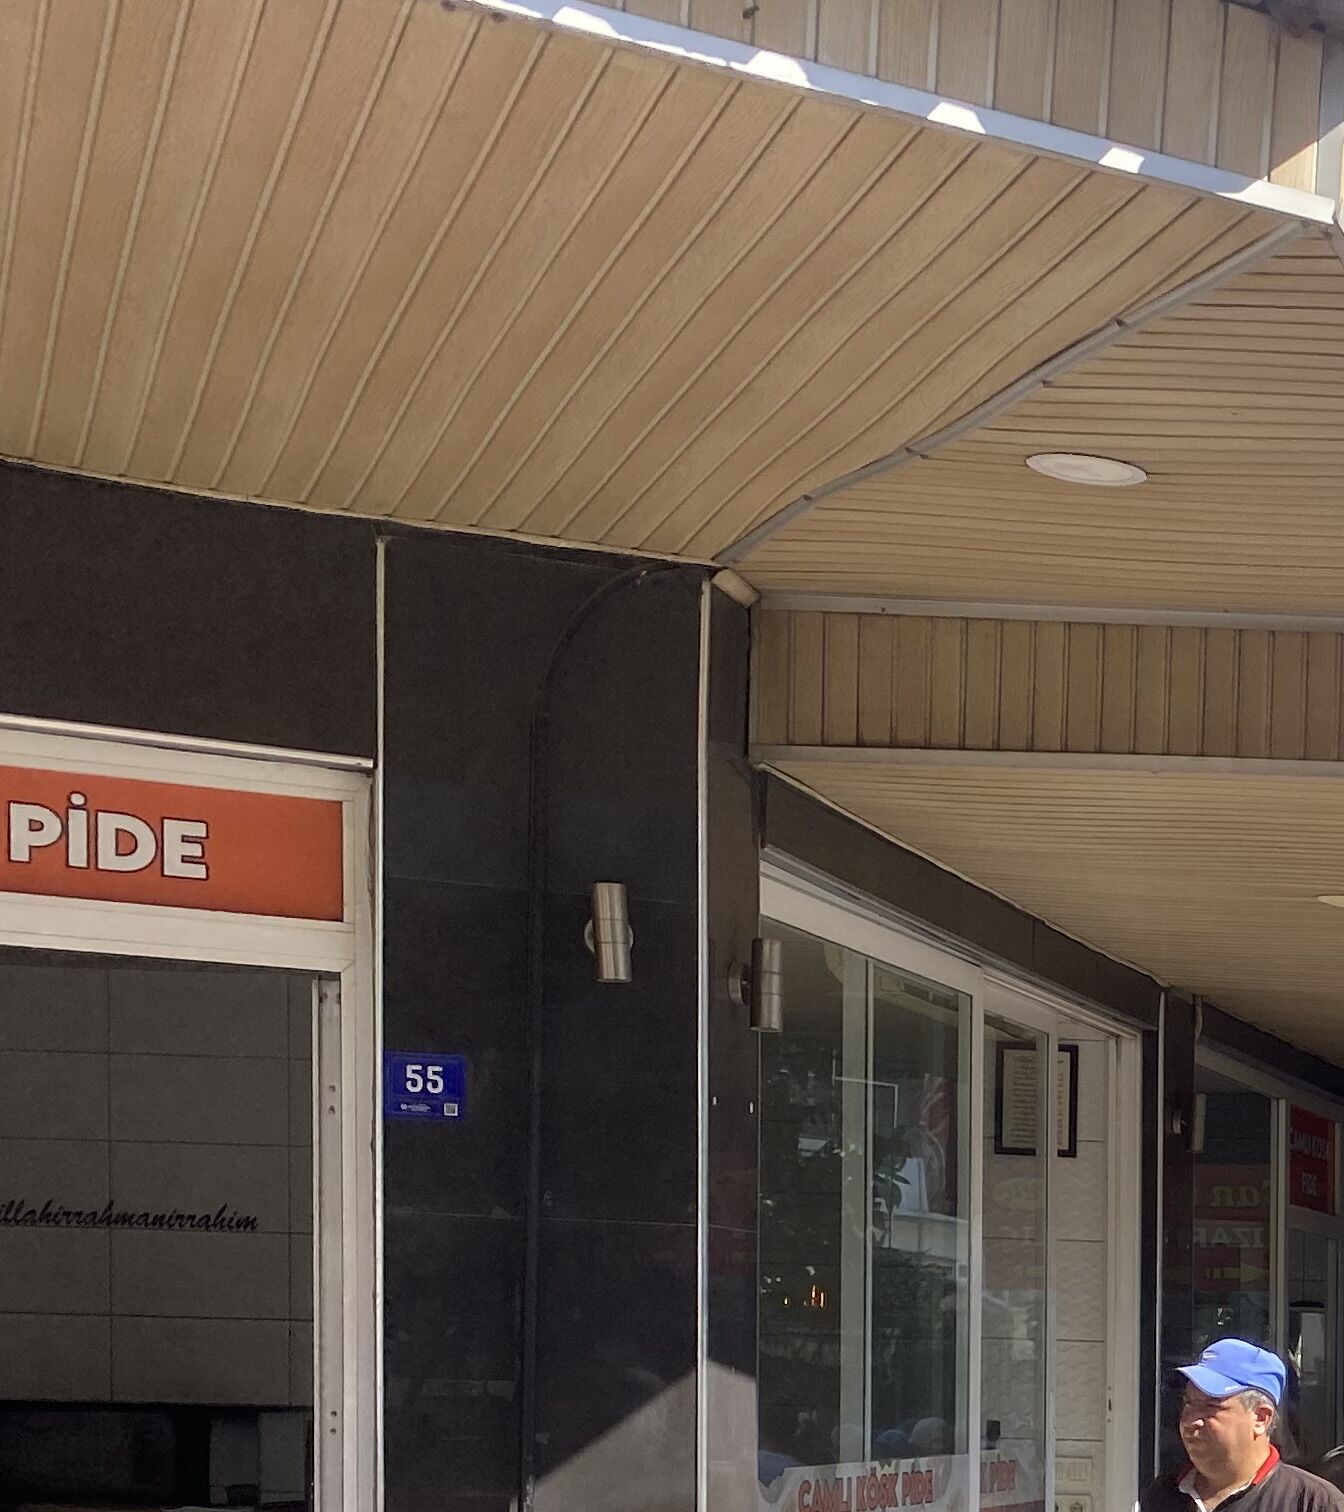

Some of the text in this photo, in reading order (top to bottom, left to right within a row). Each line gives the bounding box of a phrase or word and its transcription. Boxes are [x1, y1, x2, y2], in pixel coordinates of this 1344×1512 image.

[8, 791, 209, 881] PİDE
[405, 1064, 444, 1094] 55
[903, 1462, 934, 1507] PİDE
